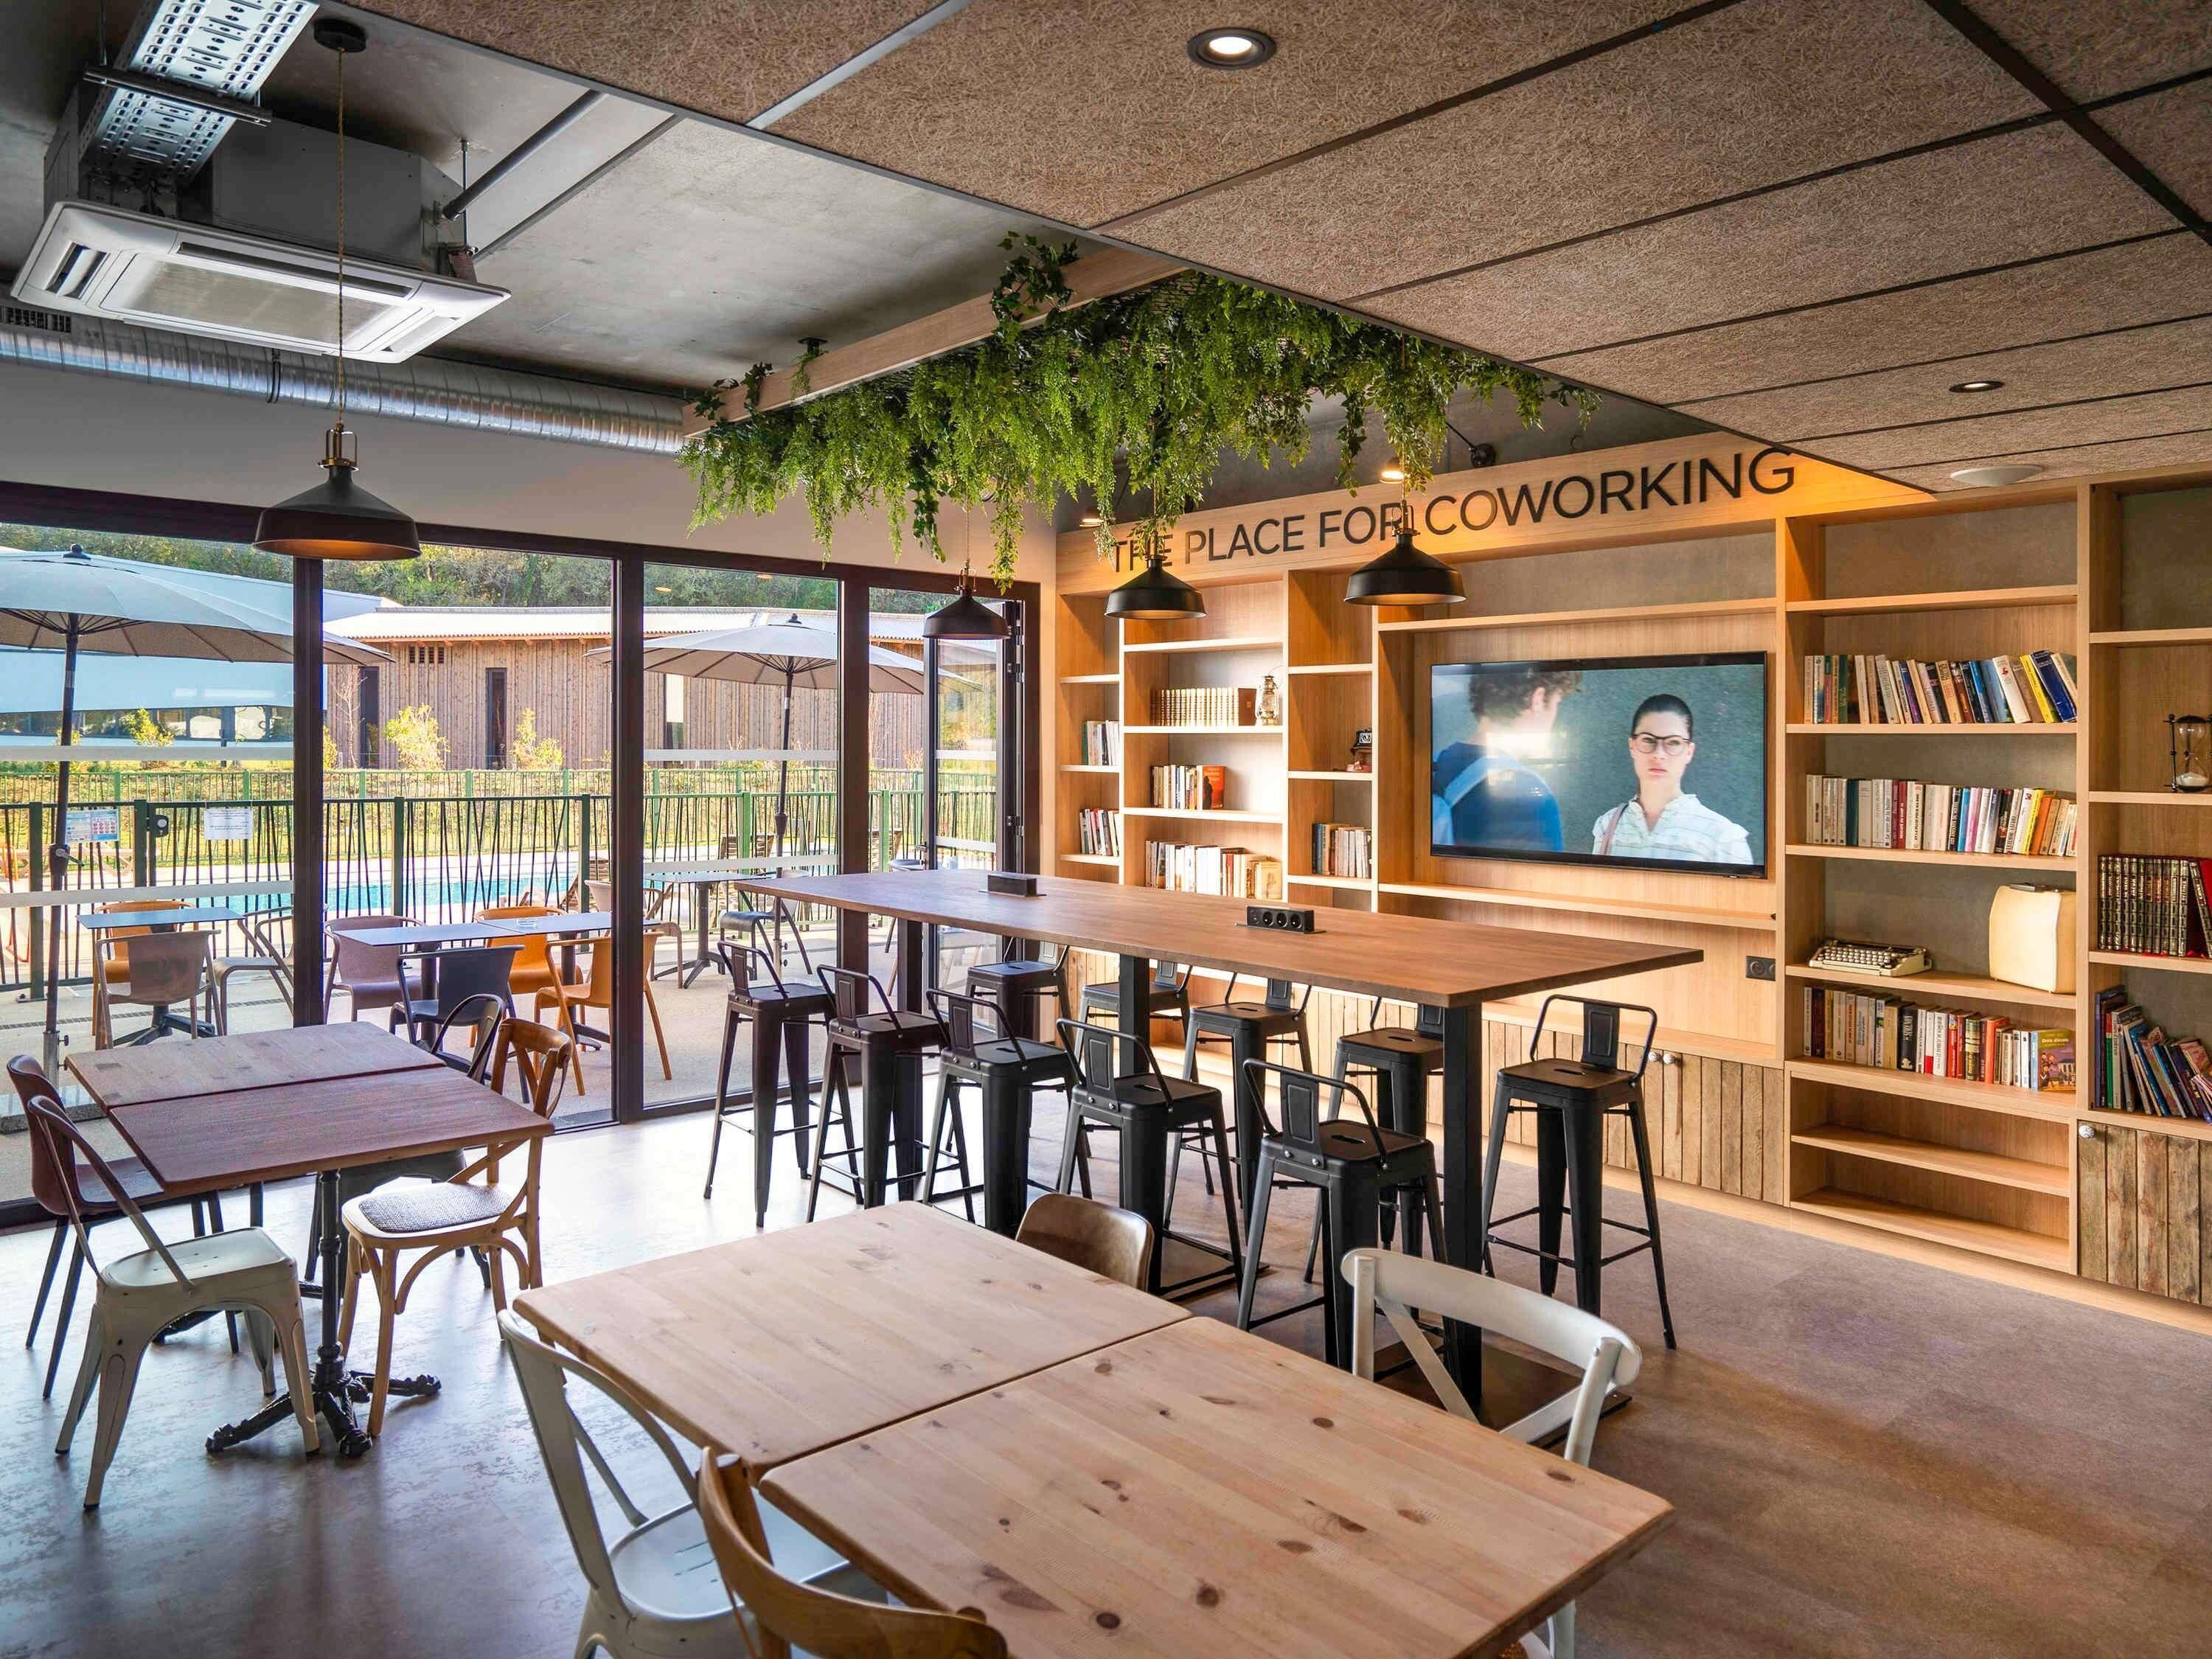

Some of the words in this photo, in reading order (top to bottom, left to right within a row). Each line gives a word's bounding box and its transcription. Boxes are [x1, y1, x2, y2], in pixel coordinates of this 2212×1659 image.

[1185, 515, 1304, 564] PLACE
[1319, 502, 1405, 548] FOR
[1425, 447, 1795, 535] COWORKING
